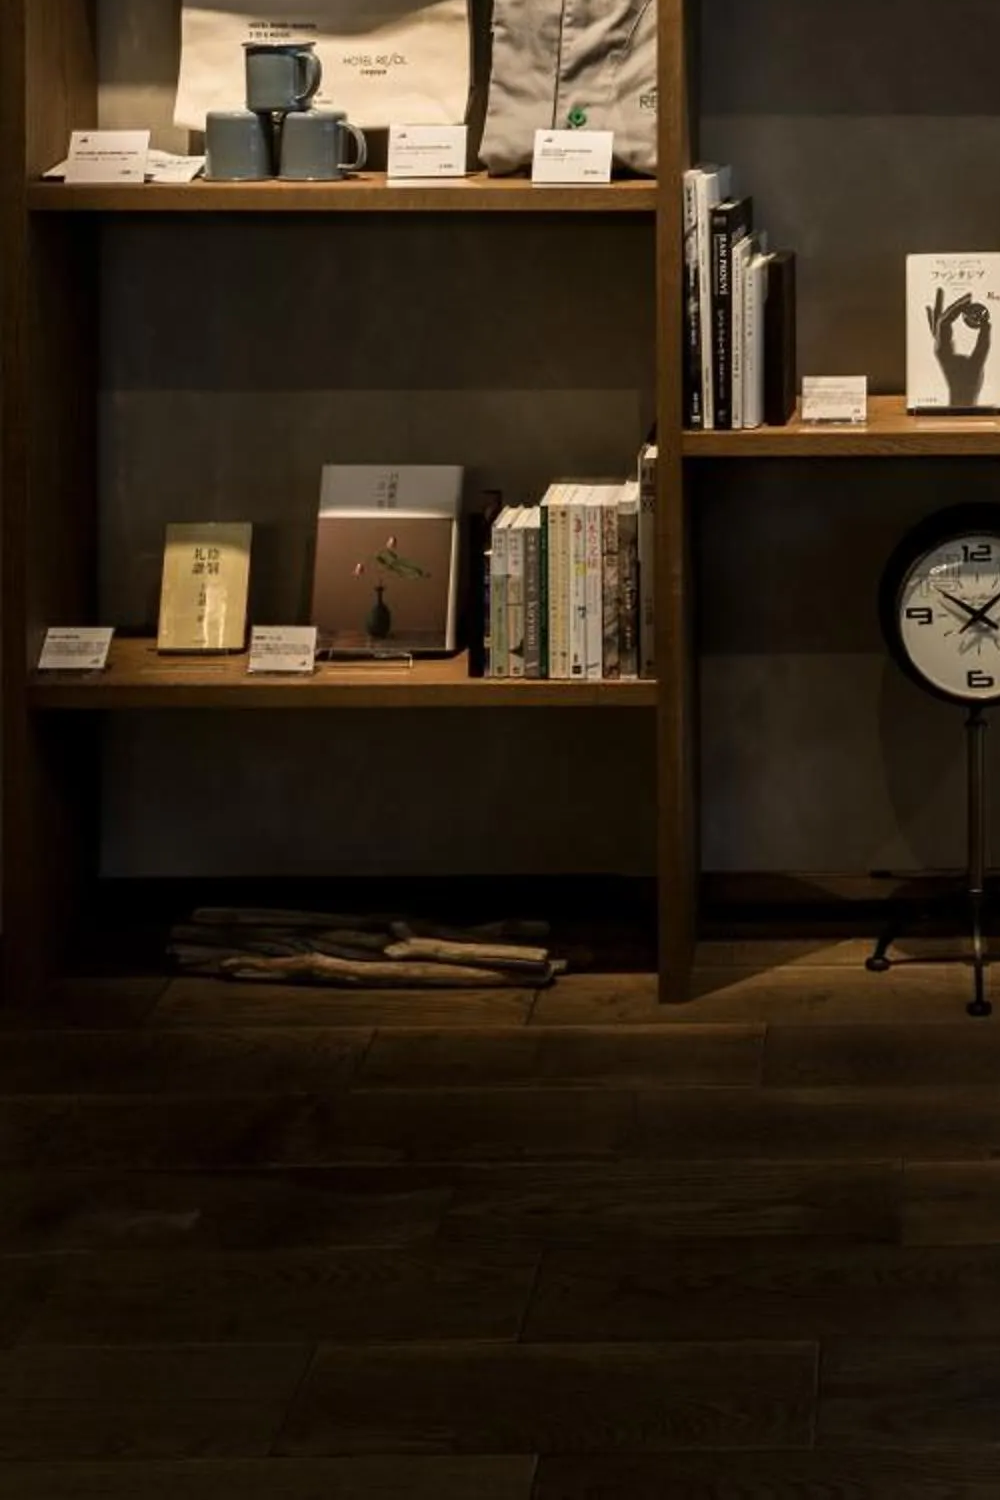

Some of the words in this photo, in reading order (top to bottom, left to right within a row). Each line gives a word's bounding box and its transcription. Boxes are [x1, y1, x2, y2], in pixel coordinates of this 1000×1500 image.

[962, 544, 992, 562] 12
[905, 607, 933, 625] 9
[967, 670, 995, 688] 6
